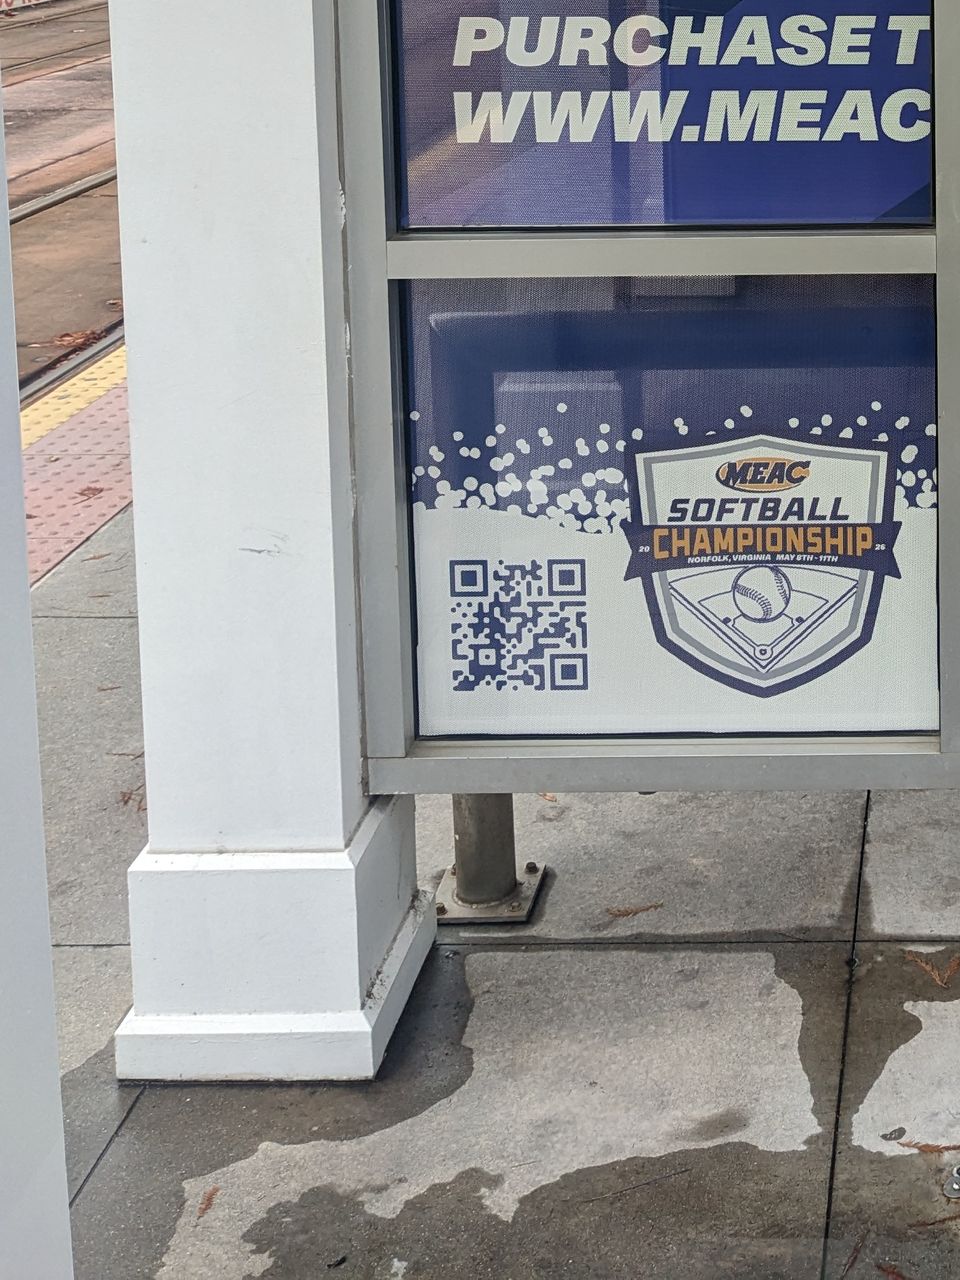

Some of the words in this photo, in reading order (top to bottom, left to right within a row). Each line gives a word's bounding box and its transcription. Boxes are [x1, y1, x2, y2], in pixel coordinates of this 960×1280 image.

[452, 14, 876, 67] PURCHASE
[723, 460, 811, 487] MEAC
[667, 496, 850, 523] SOFTBALL
[639, 545, 650, 554] 20
[653, 525, 874, 560] CHAMPIONSHIP
[687, 554, 732, 565] NORFOLK,
[732, 553, 772, 562] VIRGINIA
[775, 554, 795, 562] MAY
